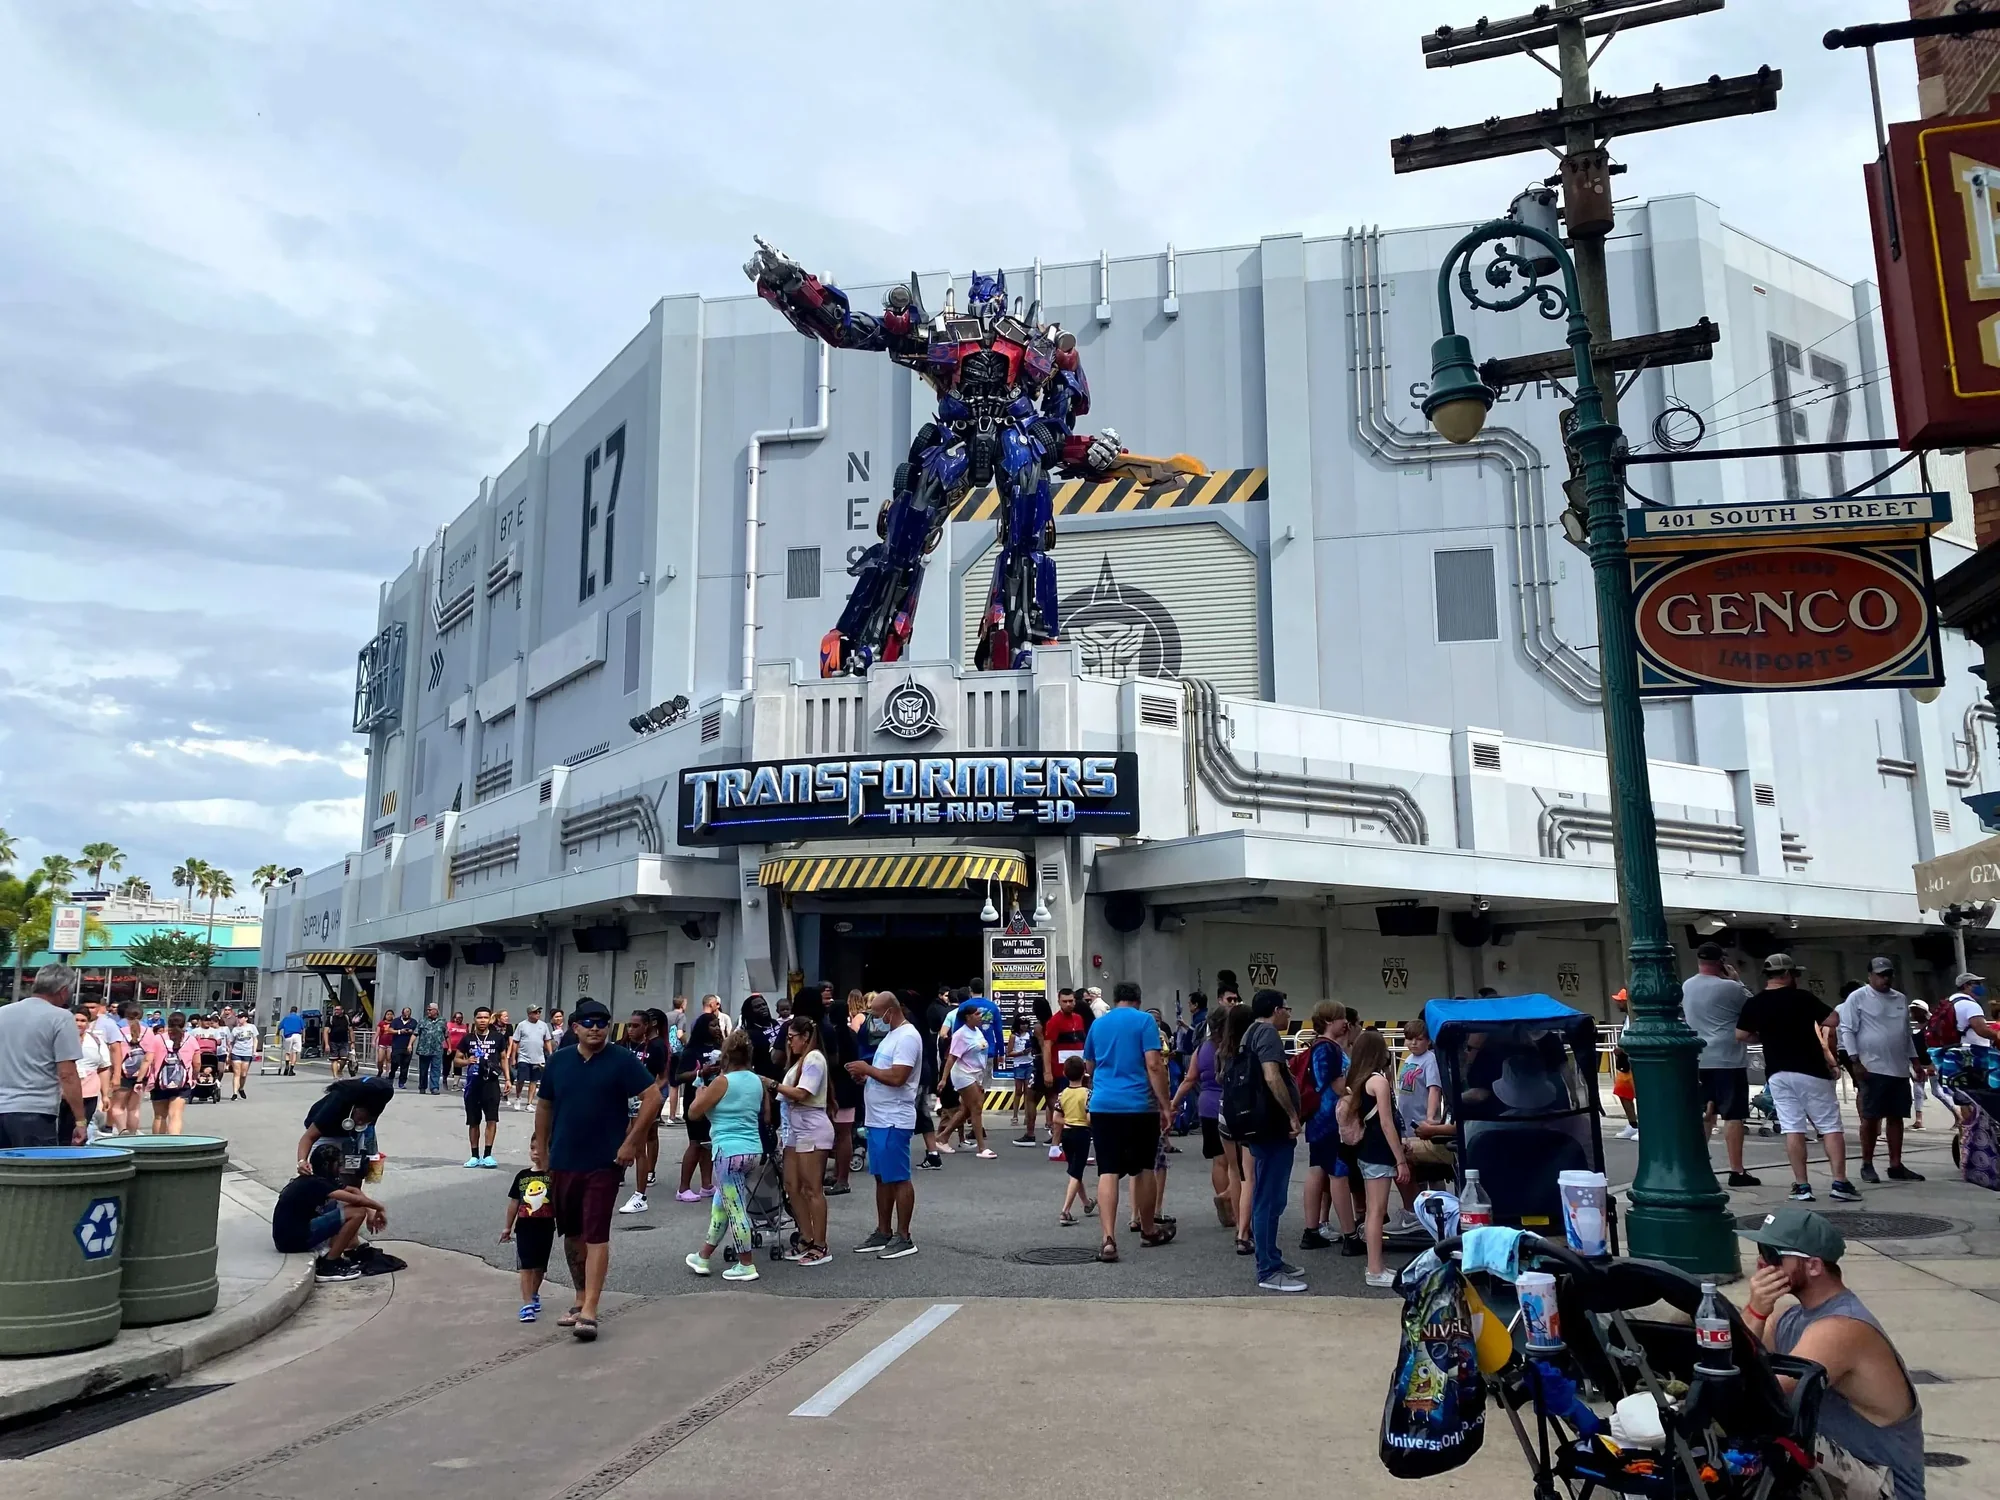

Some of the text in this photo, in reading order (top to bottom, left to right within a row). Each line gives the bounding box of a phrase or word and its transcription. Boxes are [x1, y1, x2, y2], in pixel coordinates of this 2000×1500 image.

[1658, 500, 1918, 527] 401 SOUTH STREET
[1657, 587, 1898, 636] GENCO
[1718, 644, 1854, 671] IMPORTS
[684, 757, 1117, 834] TRANSFORMERS
[884, 802, 941, 824] THE
[302, 913, 321, 938] SUPPLY
[1249, 952, 1275, 964] NEST
[1383, 957, 1405, 968] NEST
[1258, 973, 1269, 985] 10
[1392, 976, 1399, 988] 9
